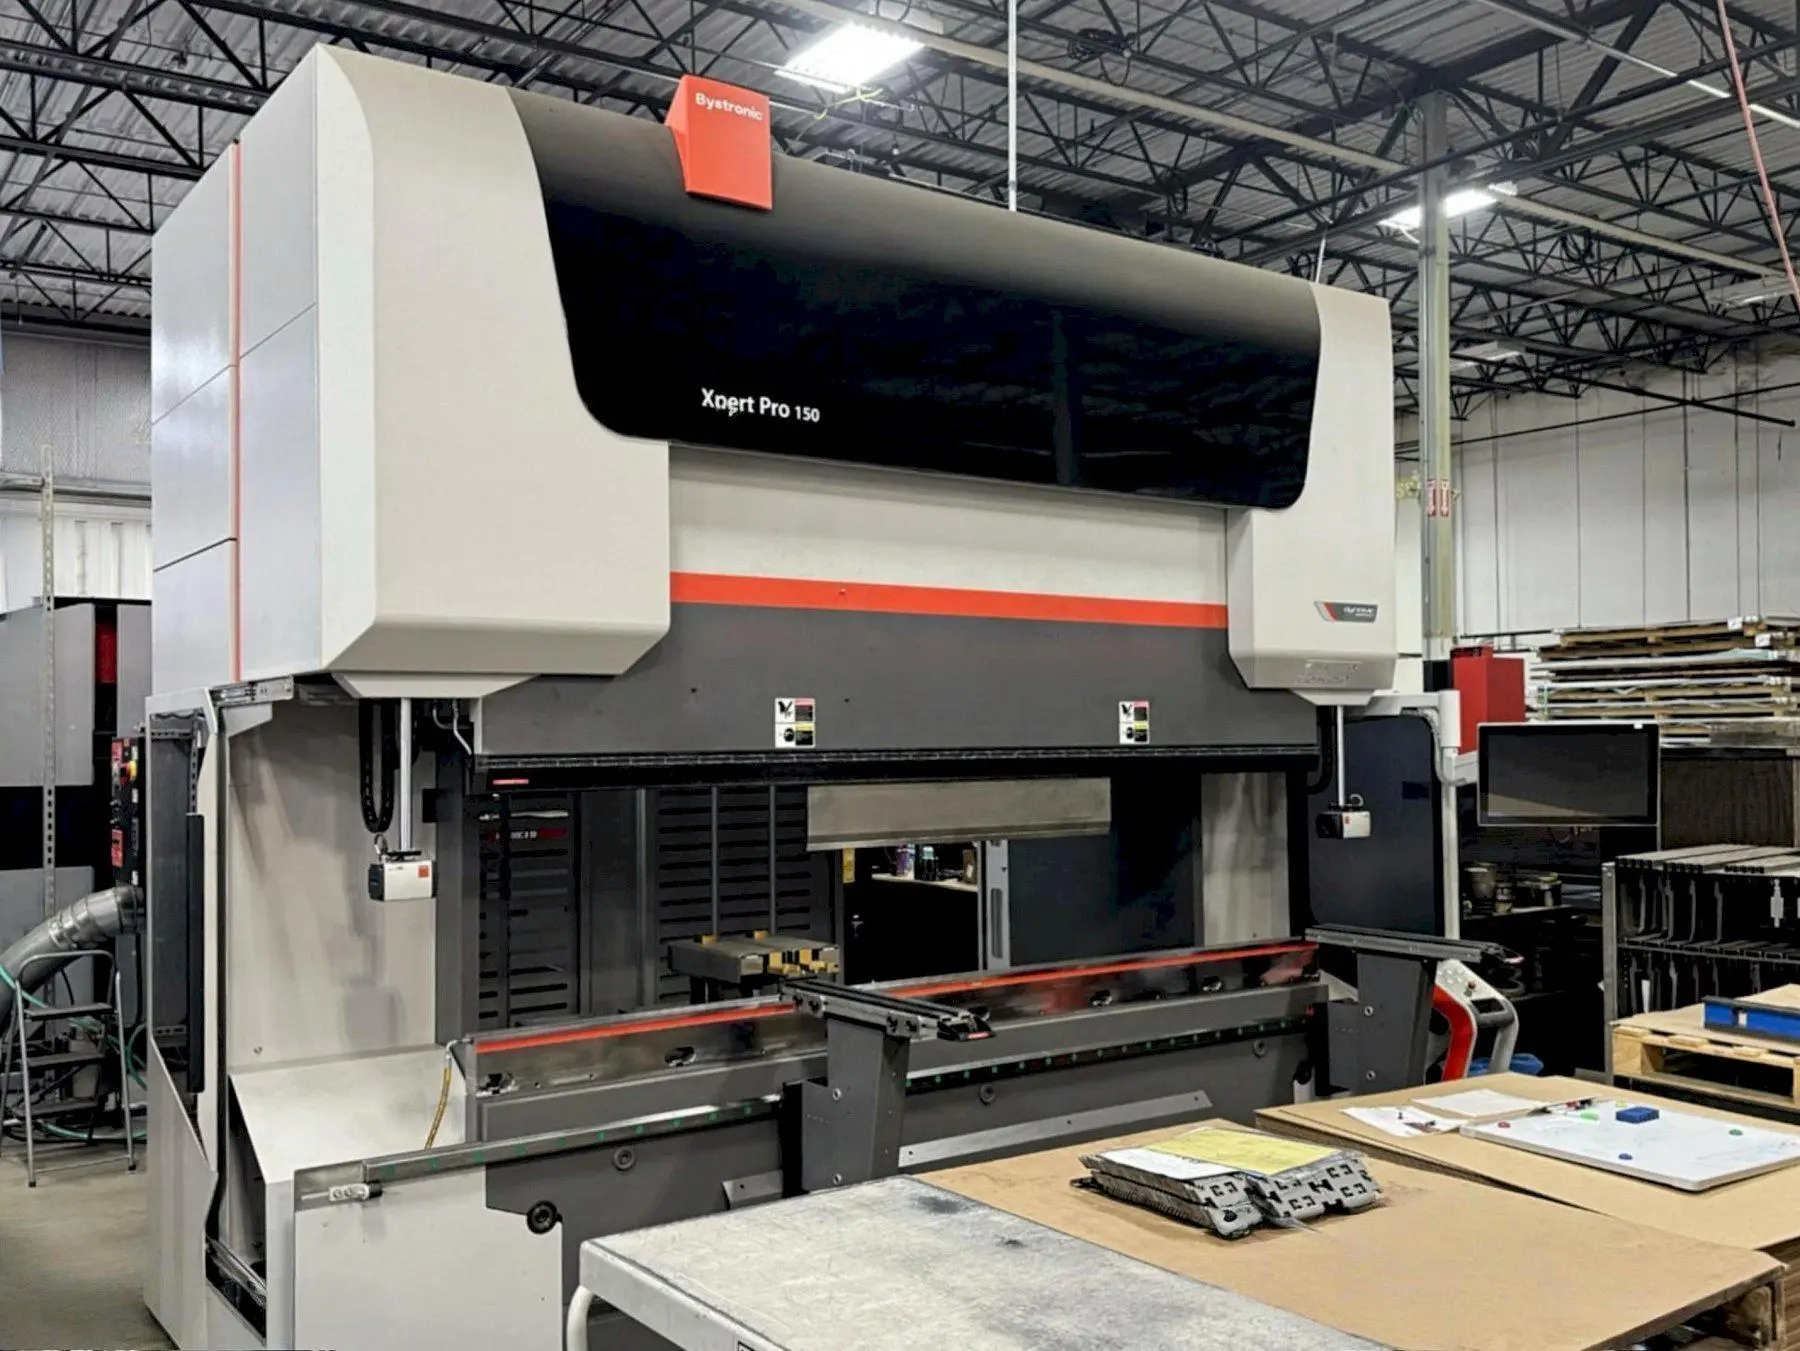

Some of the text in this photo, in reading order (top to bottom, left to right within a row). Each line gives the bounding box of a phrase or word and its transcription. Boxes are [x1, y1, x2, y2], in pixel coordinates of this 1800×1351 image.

[695, 92, 763, 121] Bystronic
[759, 396, 791, 418] Pro
[794, 405, 821, 423] 150
